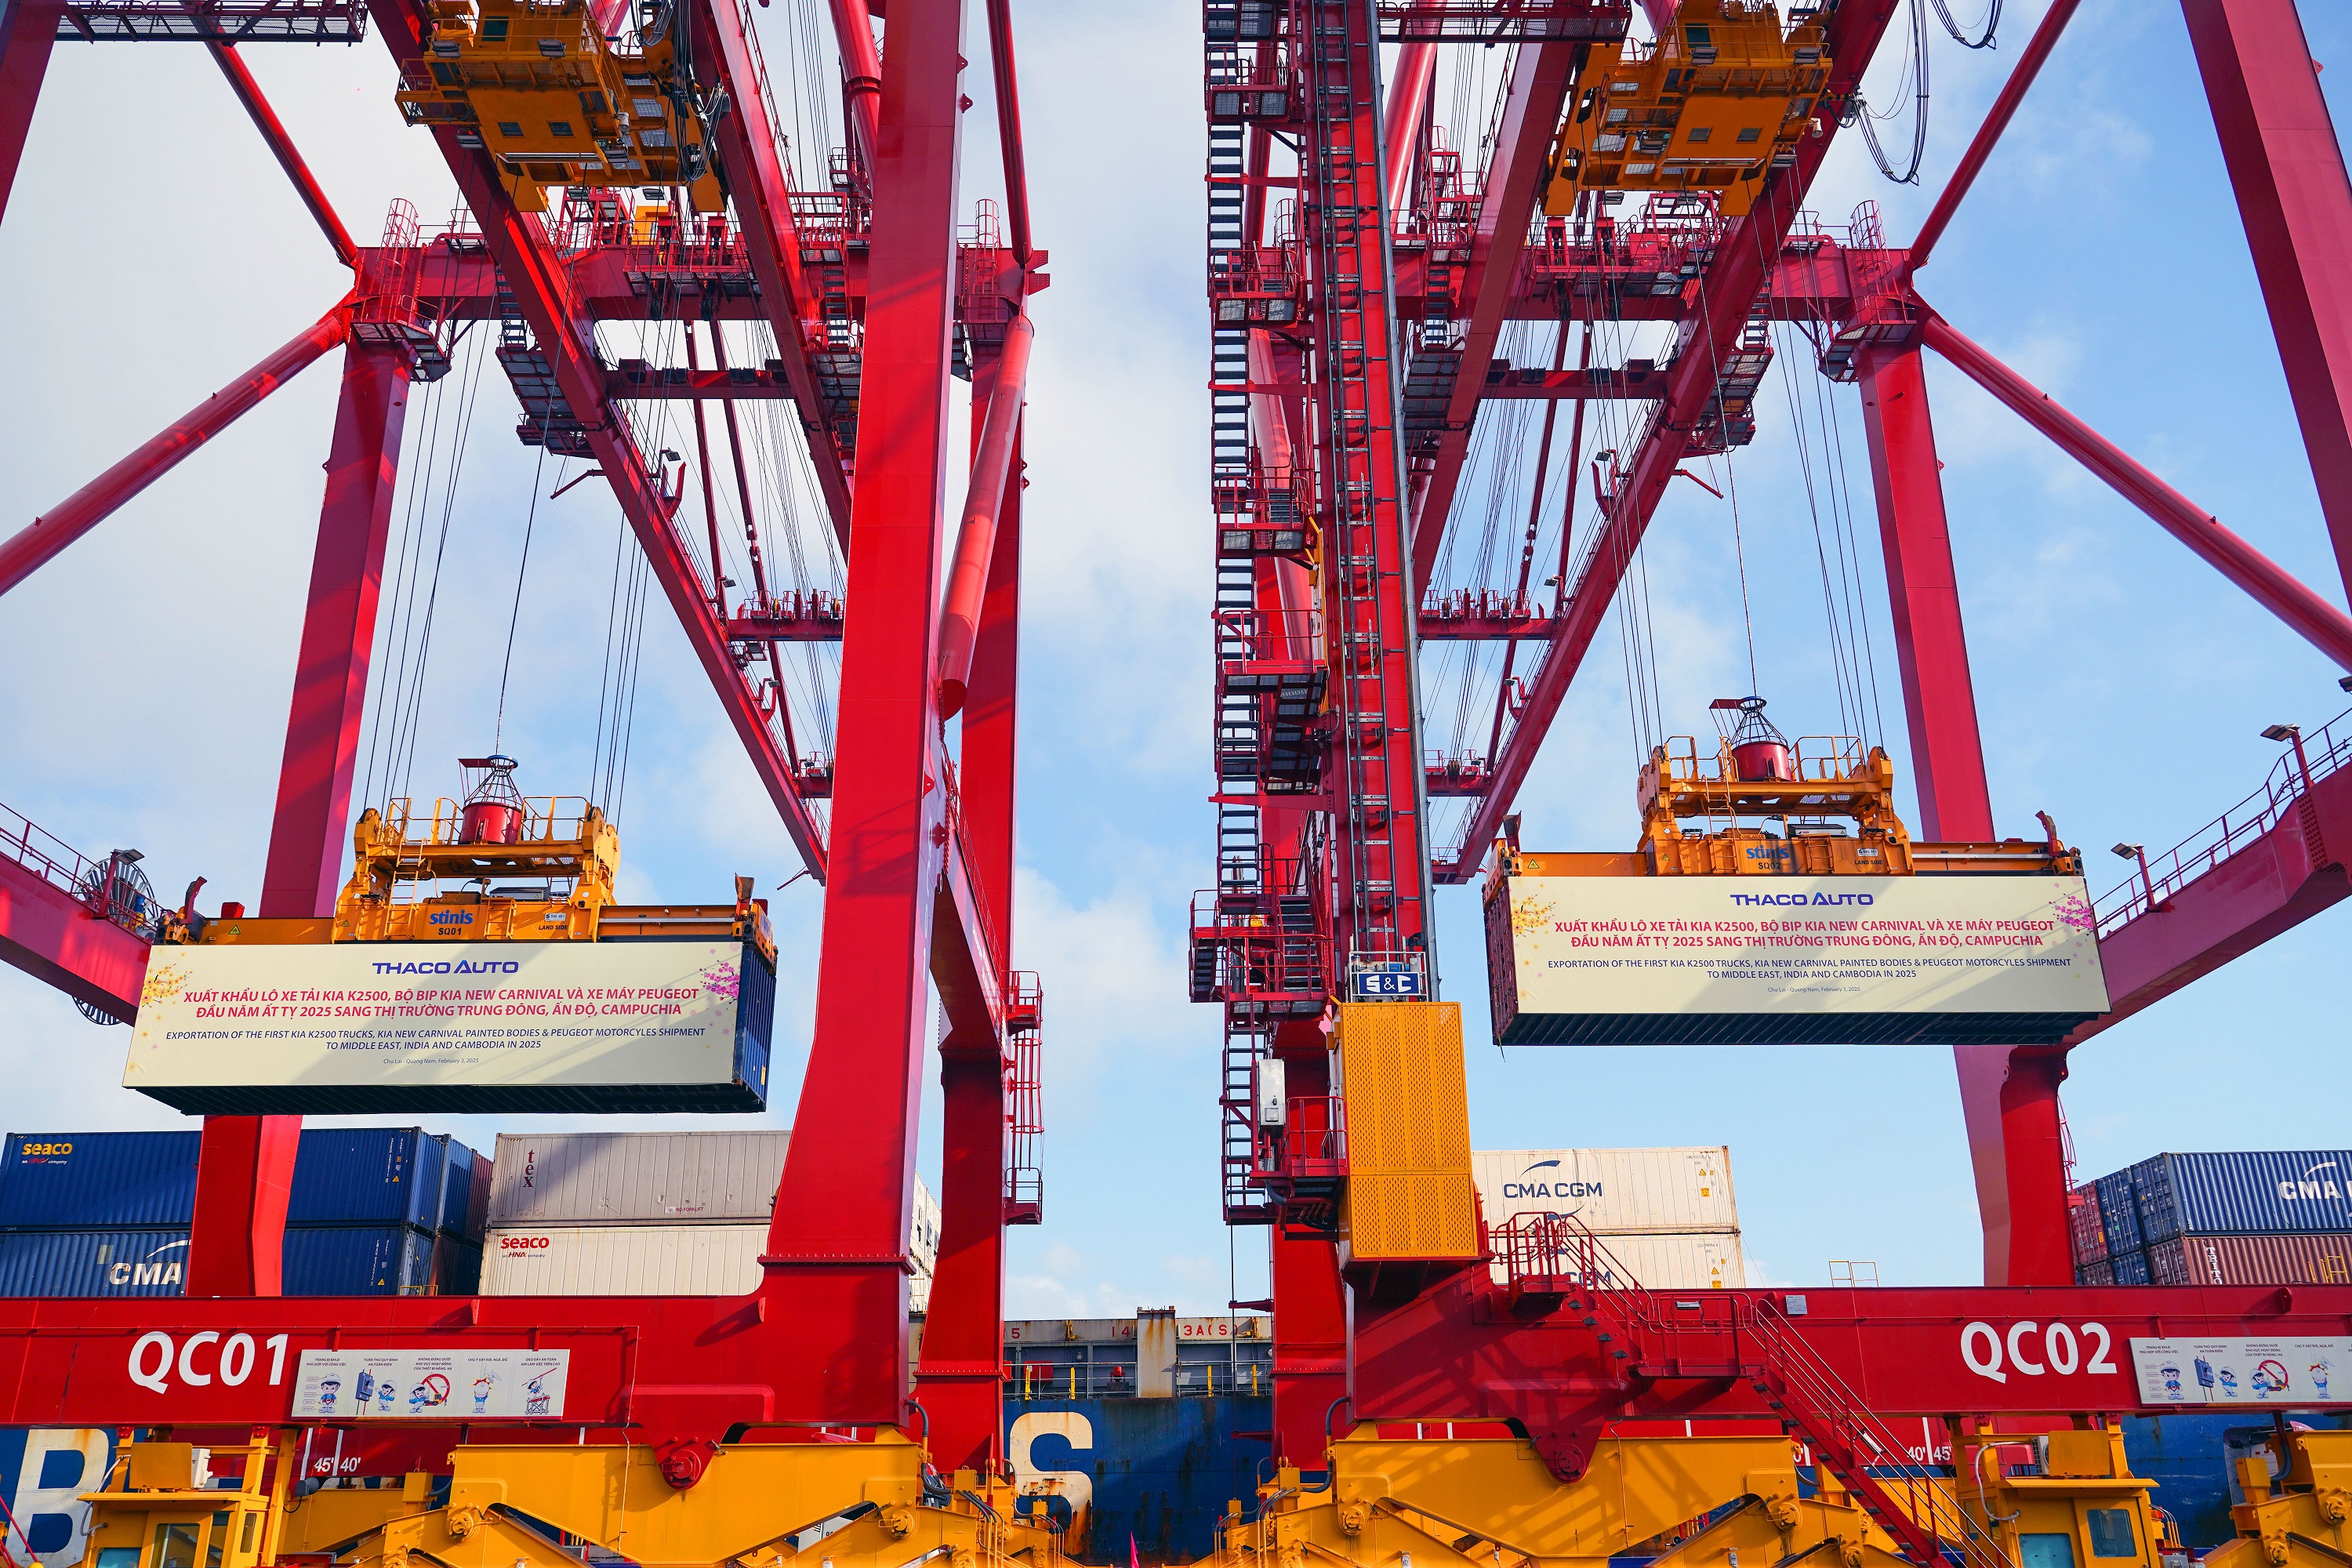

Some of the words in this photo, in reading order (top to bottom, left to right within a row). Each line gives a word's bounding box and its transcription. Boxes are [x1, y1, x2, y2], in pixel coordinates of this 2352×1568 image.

[1746, 844, 1790, 860] stinis
[1758, 862, 1781, 870] SQ02
[1730, 894, 1808, 906] THACO
[1811, 891, 1874, 906] AUTO
[429, 909, 474, 925] stinis
[437, 927, 462, 936] SQ01
[1555, 919, 1588, 933] XUẤT
[1591, 918, 1628, 933] KHẨU
[1630, 920, 1647, 933] LÔ
[1650, 921, 1666, 932] XE
[1668, 919, 1688, 932] TẢI
[1690, 921, 1713, 932] KIA
[1715, 921, 1759, 933] K2500,
[1760, 920, 1779, 932] BỘ
[1782, 921, 1802, 932] BIP
[1805, 921, 1827, 931] KIA
[1829, 921, 1858, 931] NEW
[1861, 920, 1926, 931] CARNIVAL
[1926, 919, 1945, 931] VÀ
[1947, 920, 1964, 931] XE
[1965, 919, 1993, 931] MÁY
[1996, 920, 2054, 931] PEUGEOT
[1570, 935, 1599, 948] ĐẦU
[1602, 935, 1633, 947] NĂM
[1636, 935, 1651, 946] ẤT
[1653, 936, 1669, 949] TỴ
[1672, 937, 1704, 947] 2025
[1706, 936, 1743, 947] SANG
[1744, 936, 1766, 949] THỊ
[1768, 935, 1824, 946] TRƯỜNG
[1825, 935, 1870, 946] TRUNG
[1872, 935, 1915, 947] ĐÔNG,
[1918, 935, 1937, 946] ẤN
[1939, 935, 1962, 948] ĐỘ,
[1965, 935, 2044, 946] CAMPUCHIA
[372, 962, 452, 975] THACO
[453, 960, 519, 975] AUTO
[1548, 960, 1610, 968] EXPORTATION
[1715, 960, 1753, 968] TRUCKS,
[1965, 958, 2025, 967] MOTORCYLES
[2026, 958, 2071, 967] SHIPMENT
[183, 989, 220, 1003] XUẤT
[220, 987, 260, 1002] KHẨU
[261, 989, 279, 1001] LÔ
[281, 990, 298, 1002] XE
[300, 988, 321, 1001] TẢI
[322, 990, 344, 1001] KIA
[347, 990, 391, 1003] K2500,
[394, 989, 414, 1004] BỘ
[416, 990, 438, 1001] BIP
[441, 990, 462, 1000] KIA
[465, 989, 496, 1000] NEW
[498, 989, 564, 1000] CARNIVAL
[567, 989, 584, 1000] VÀ
[586, 989, 604, 1000] XE
[606, 989, 636, 999] MÁY
[638, 989, 699, 1000] PEUGEOT
[196, 1005, 226, 1018] ĐẦU
[227, 1005, 260, 1018] NĂM
[262, 1004, 280, 1017] ẤT
[281, 1006, 298, 1020] TỴ
[299, 1006, 332, 1017] 2025
[334, 1006, 372, 1017] SANG
[374, 1006, 396, 1019] THỊ
[398, 1005, 454, 1017] TRƯỜNG
[458, 1004, 503, 1016] TRUNG
[506, 1004, 549, 1016] ĐÔNG,
[552, 1004, 572, 1015] ẤN
[575, 1002, 598, 1018] ĐỘ,
[601, 1004, 681, 1015] CAMPUCHIA
[166, 1031, 229, 1040] EXPORTATION
[339, 1030, 376, 1040] TRUCKS,
[506, 1029, 540, 1037] BODIES
[542, 1029, 549, 1037] &
[659, 1028, 706, 1036] SHIPMENT
[378, 1041, 402, 1051] EAST,
[404, 1041, 430, 1050] INDIA
[455, 1040, 505, 1049] CAMBODIA
[406, 1058, 423, 1066] Quang
[437, 1057, 460, 1065] February
[21, 1142, 73, 1156] seaco
[523, 1149, 535, 1188] tex
[1503, 1182, 1552, 1199] CMA
[1554, 1182, 1602, 1198] CGM
[2278, 1180, 2343, 1200] CMA
[500, 1236, 550, 1250] seaco
[108, 1261, 182, 1286] CMA
[1960, 1320, 2118, 1385] QC02
[128, 1330, 289, 1394] QC01
[1933, 1446, 1951, 1461] 45'
[314, 1456, 335, 1473] 45'
[339, 1455, 362, 1472] 40'
